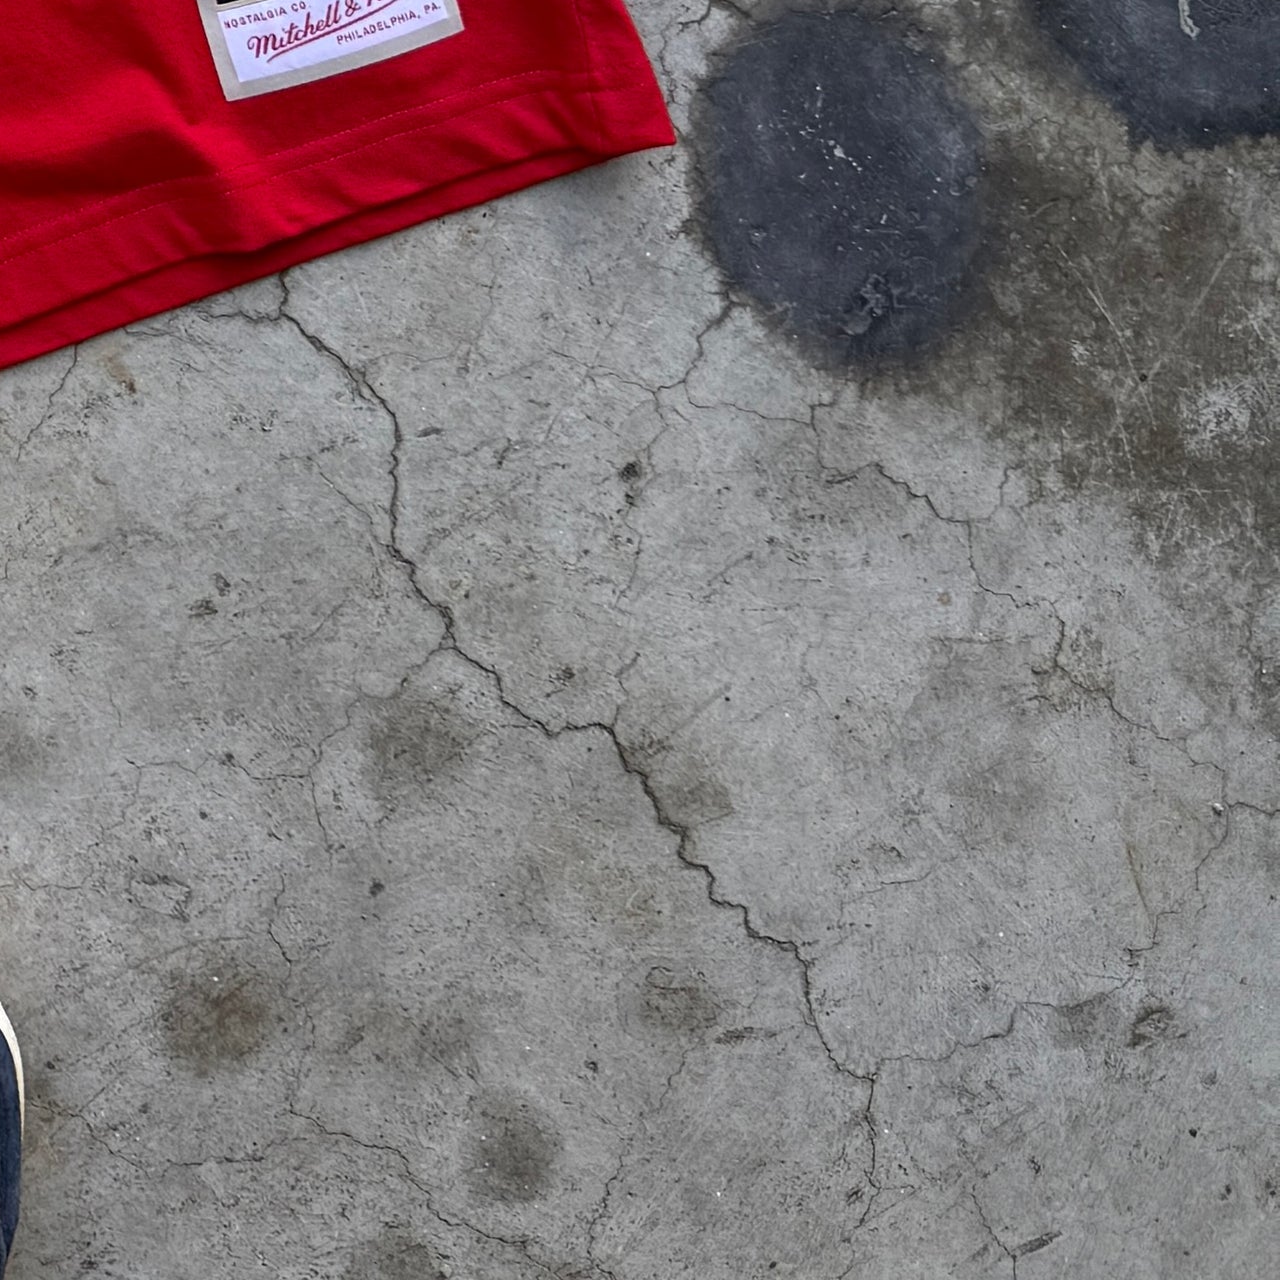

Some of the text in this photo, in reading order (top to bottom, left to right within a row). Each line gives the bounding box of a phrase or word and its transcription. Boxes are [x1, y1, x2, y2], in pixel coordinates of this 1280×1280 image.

[224, 7, 287, 29] NOSTALGIA
[247, 0, 340, 58] Mitchell
[336, 3, 441, 45] PHILADELPHIA, PA.
